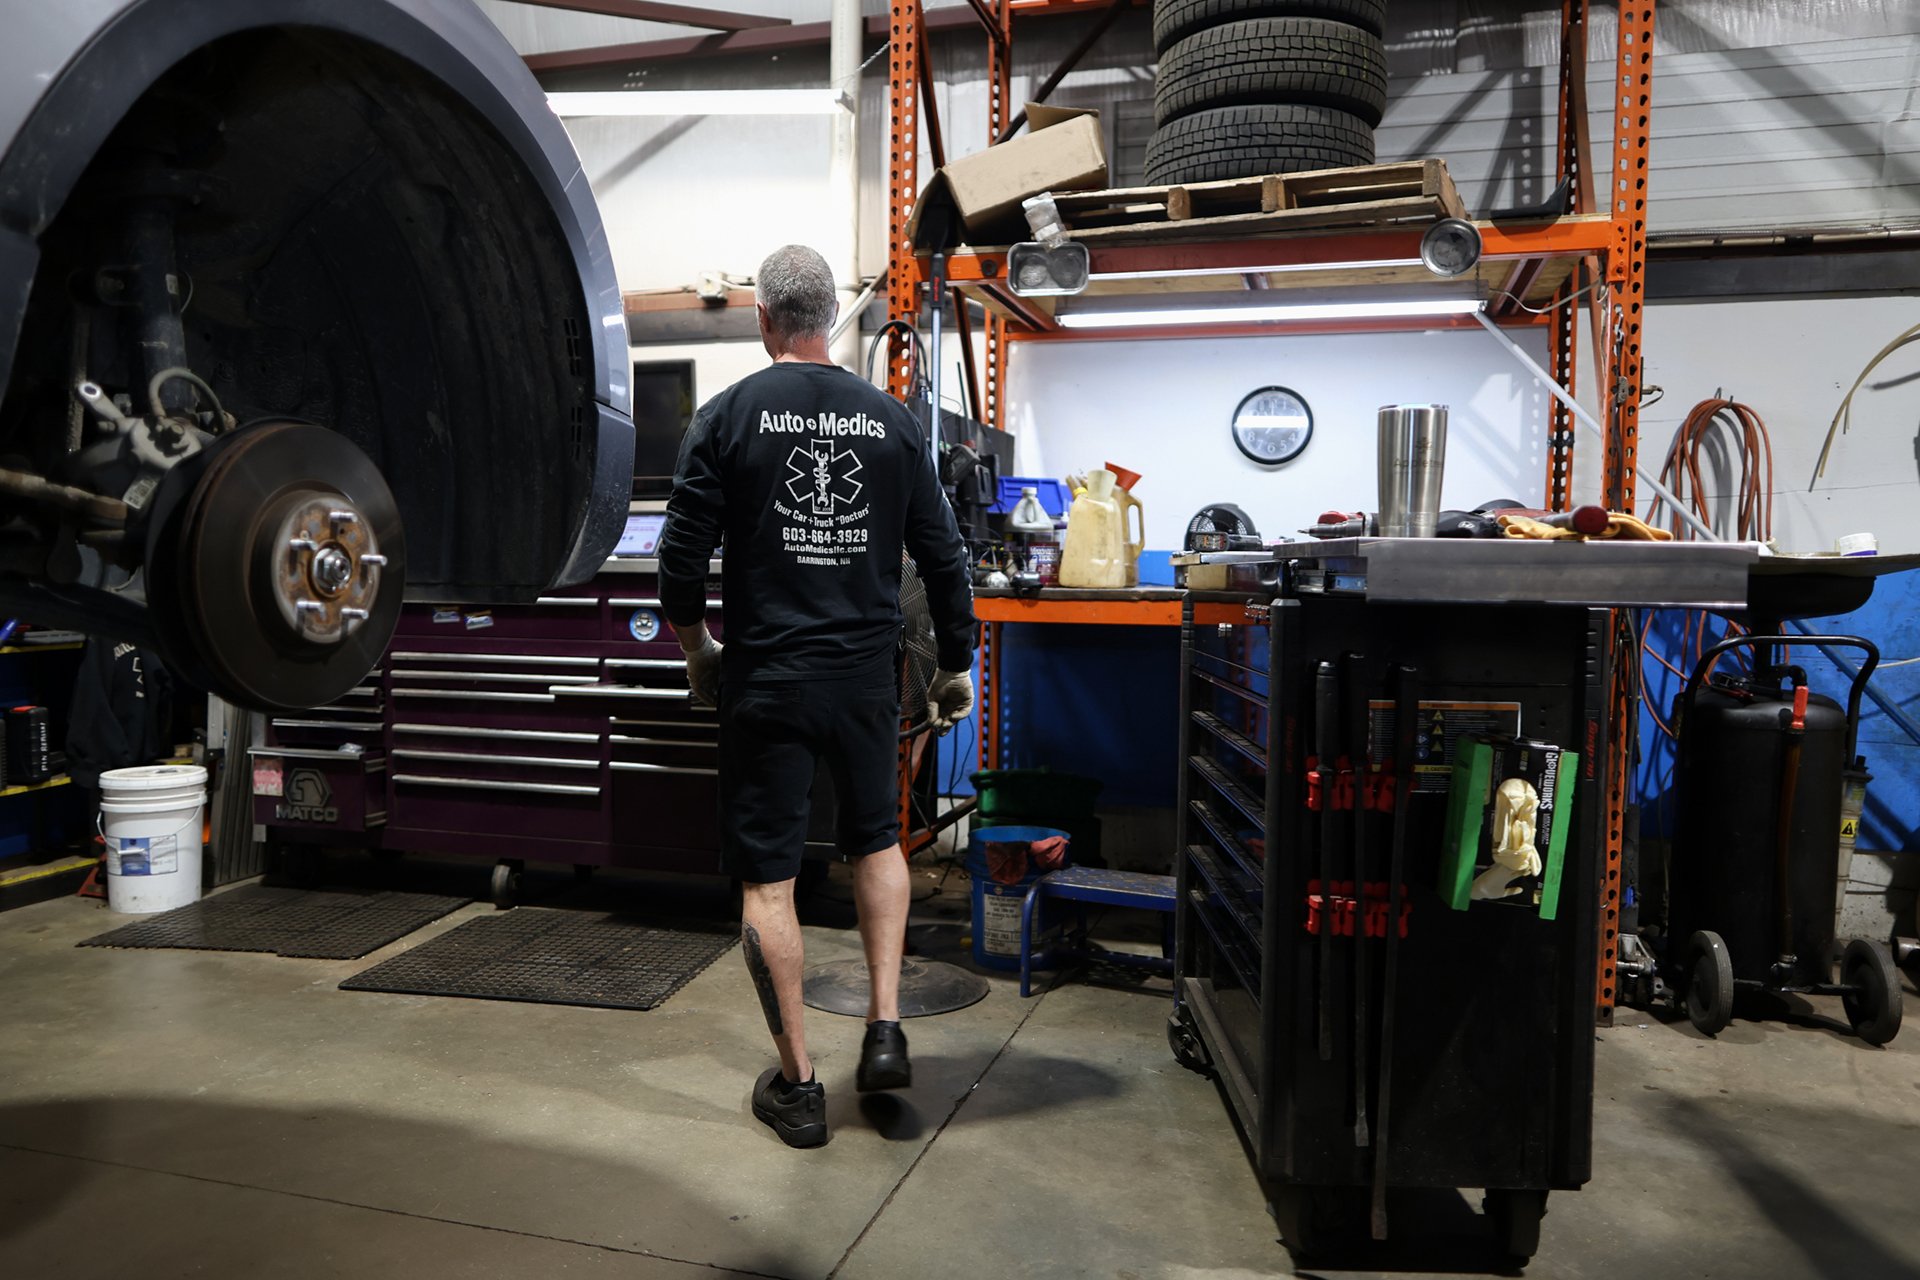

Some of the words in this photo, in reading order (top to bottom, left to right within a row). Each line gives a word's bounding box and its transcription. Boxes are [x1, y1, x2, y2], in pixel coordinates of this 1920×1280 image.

[759, 410, 805, 434] Auto
[818, 412, 886, 439] Medics
[773, 499, 792, 517] Your
[782, 526, 868, 544] 603-664-3929
[1540, 752, 1559, 811] GLOVEWORKS
[275, 804, 338, 822] MATCO
